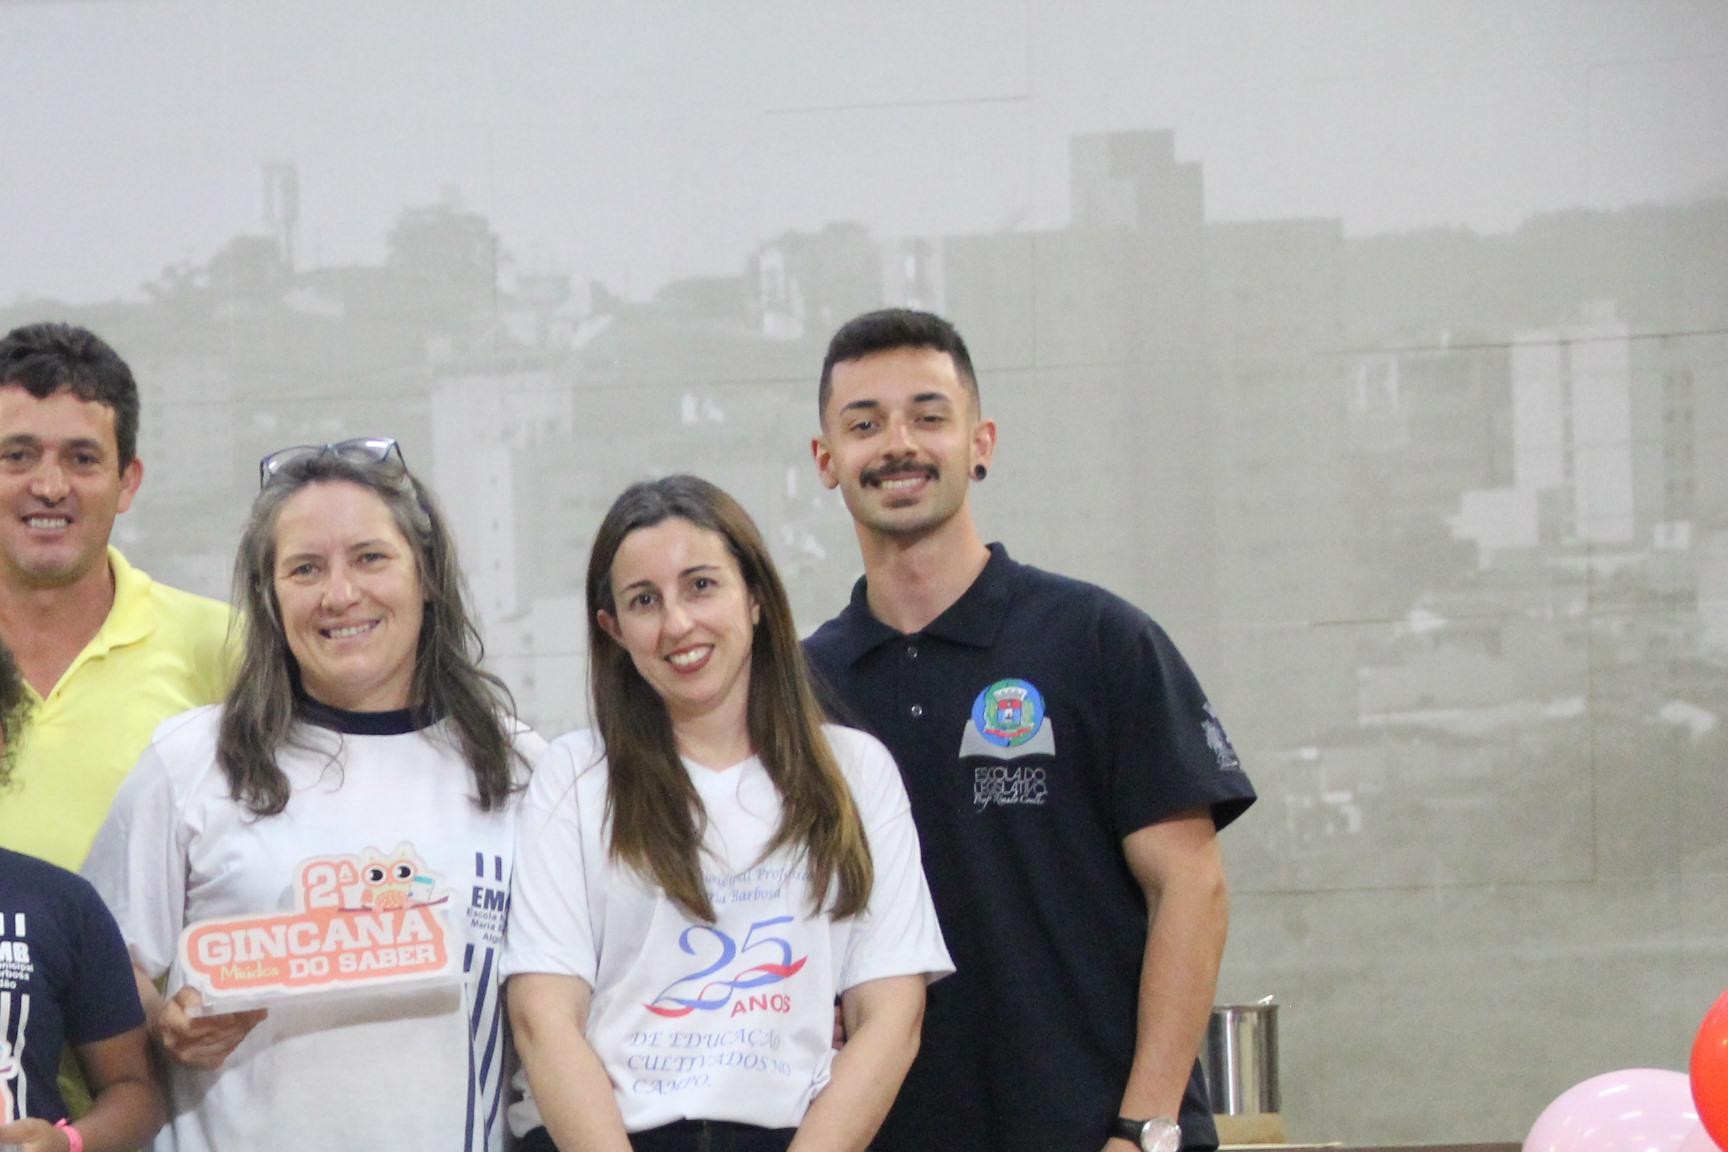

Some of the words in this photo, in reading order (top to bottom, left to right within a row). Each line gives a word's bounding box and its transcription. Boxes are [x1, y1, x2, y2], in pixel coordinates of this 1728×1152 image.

[975, 766, 1021, 781] ESCOLA
[1024, 767, 1047, 782] DO
[198, 909, 433, 965] GINCANA
[221, 964, 279, 981] Miúdos
[289, 956, 329, 979] DO
[339, 944, 436, 973] SABER
[650, 916, 798, 1012] 25
[731, 994, 791, 1018] ANOS
[631, 1031, 662, 1048] DE
